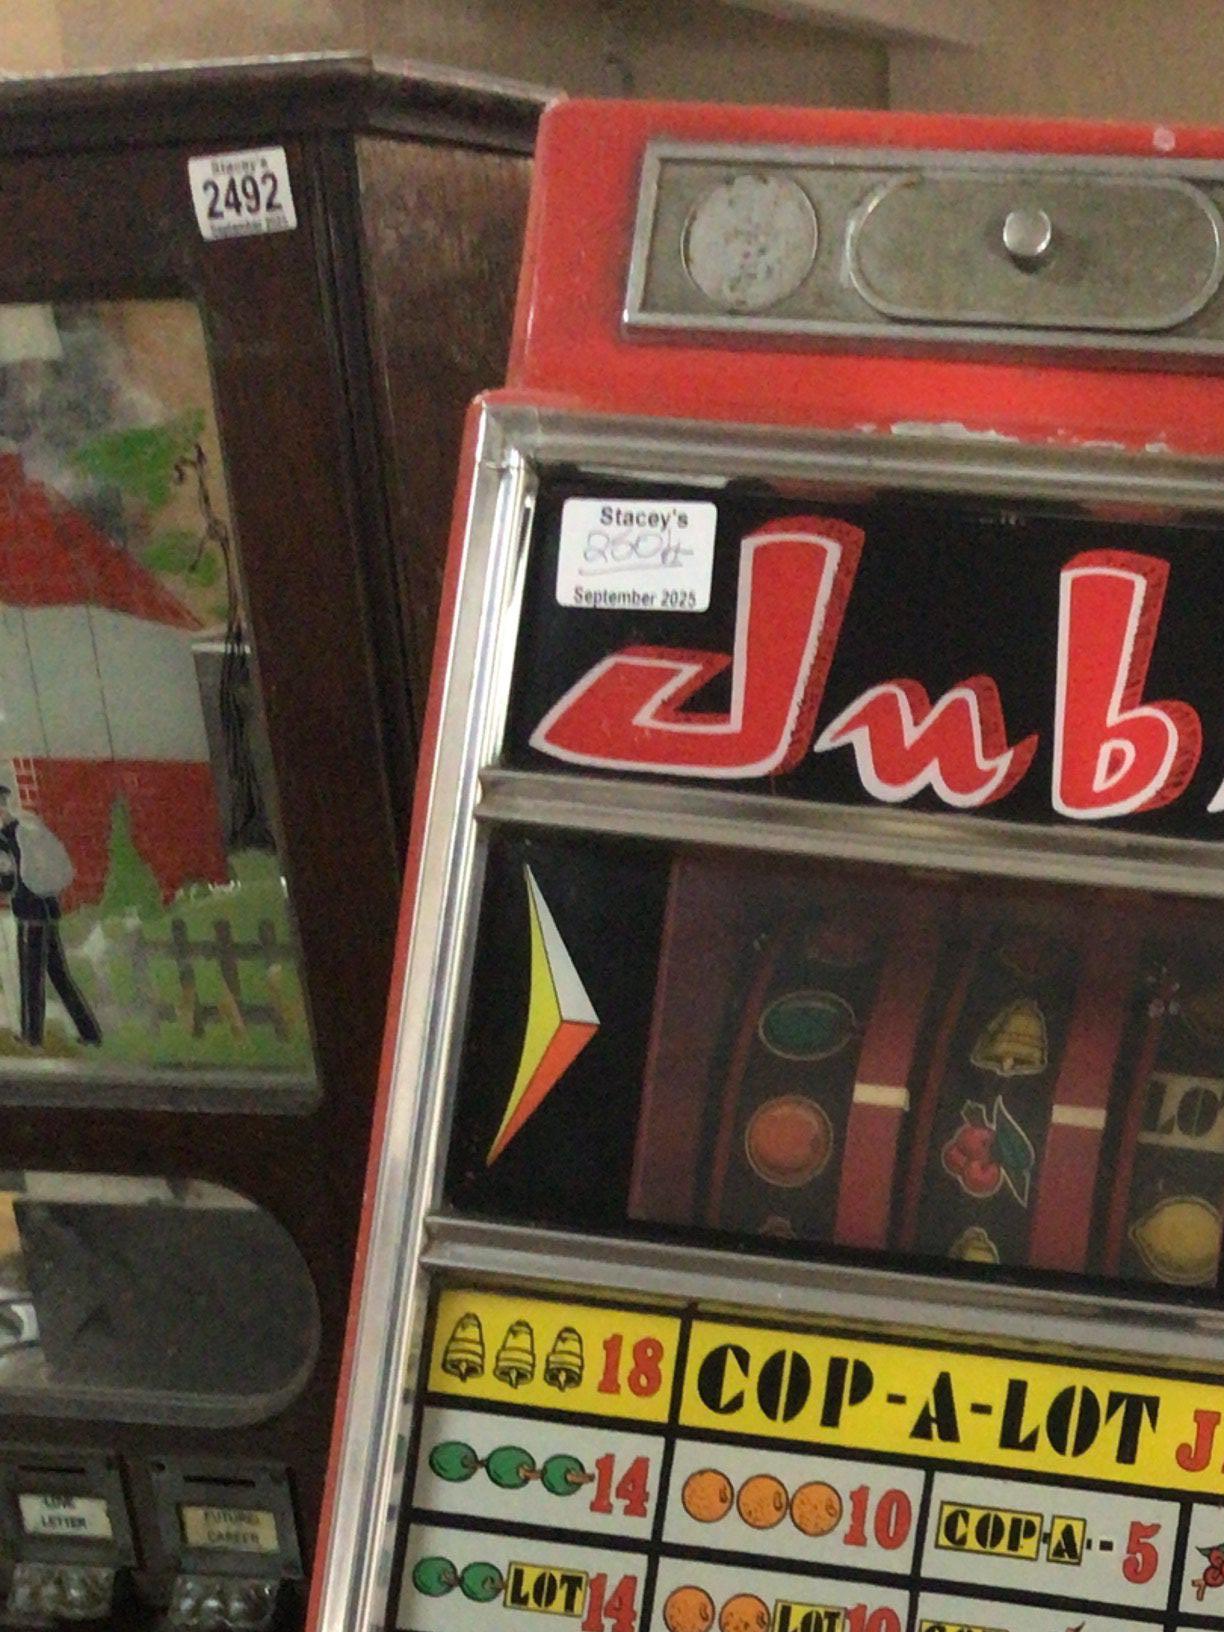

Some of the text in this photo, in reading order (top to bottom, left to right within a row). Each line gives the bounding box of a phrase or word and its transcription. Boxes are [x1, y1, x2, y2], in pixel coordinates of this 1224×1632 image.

[203, 171, 284, 219] 2492
[600, 506, 689, 532] Stacey's
[573, 585, 698, 609] September 2025
[597, 1333, 664, 1398] 18
[697, 1343, 1162, 1466] COP-A-LOT
[589, 1452, 651, 1518] 14
[842, 1484, 913, 1550] 10
[943, 1509, 1162, 1585] COP A 5
[509, 1569, 584, 1614] LOT
